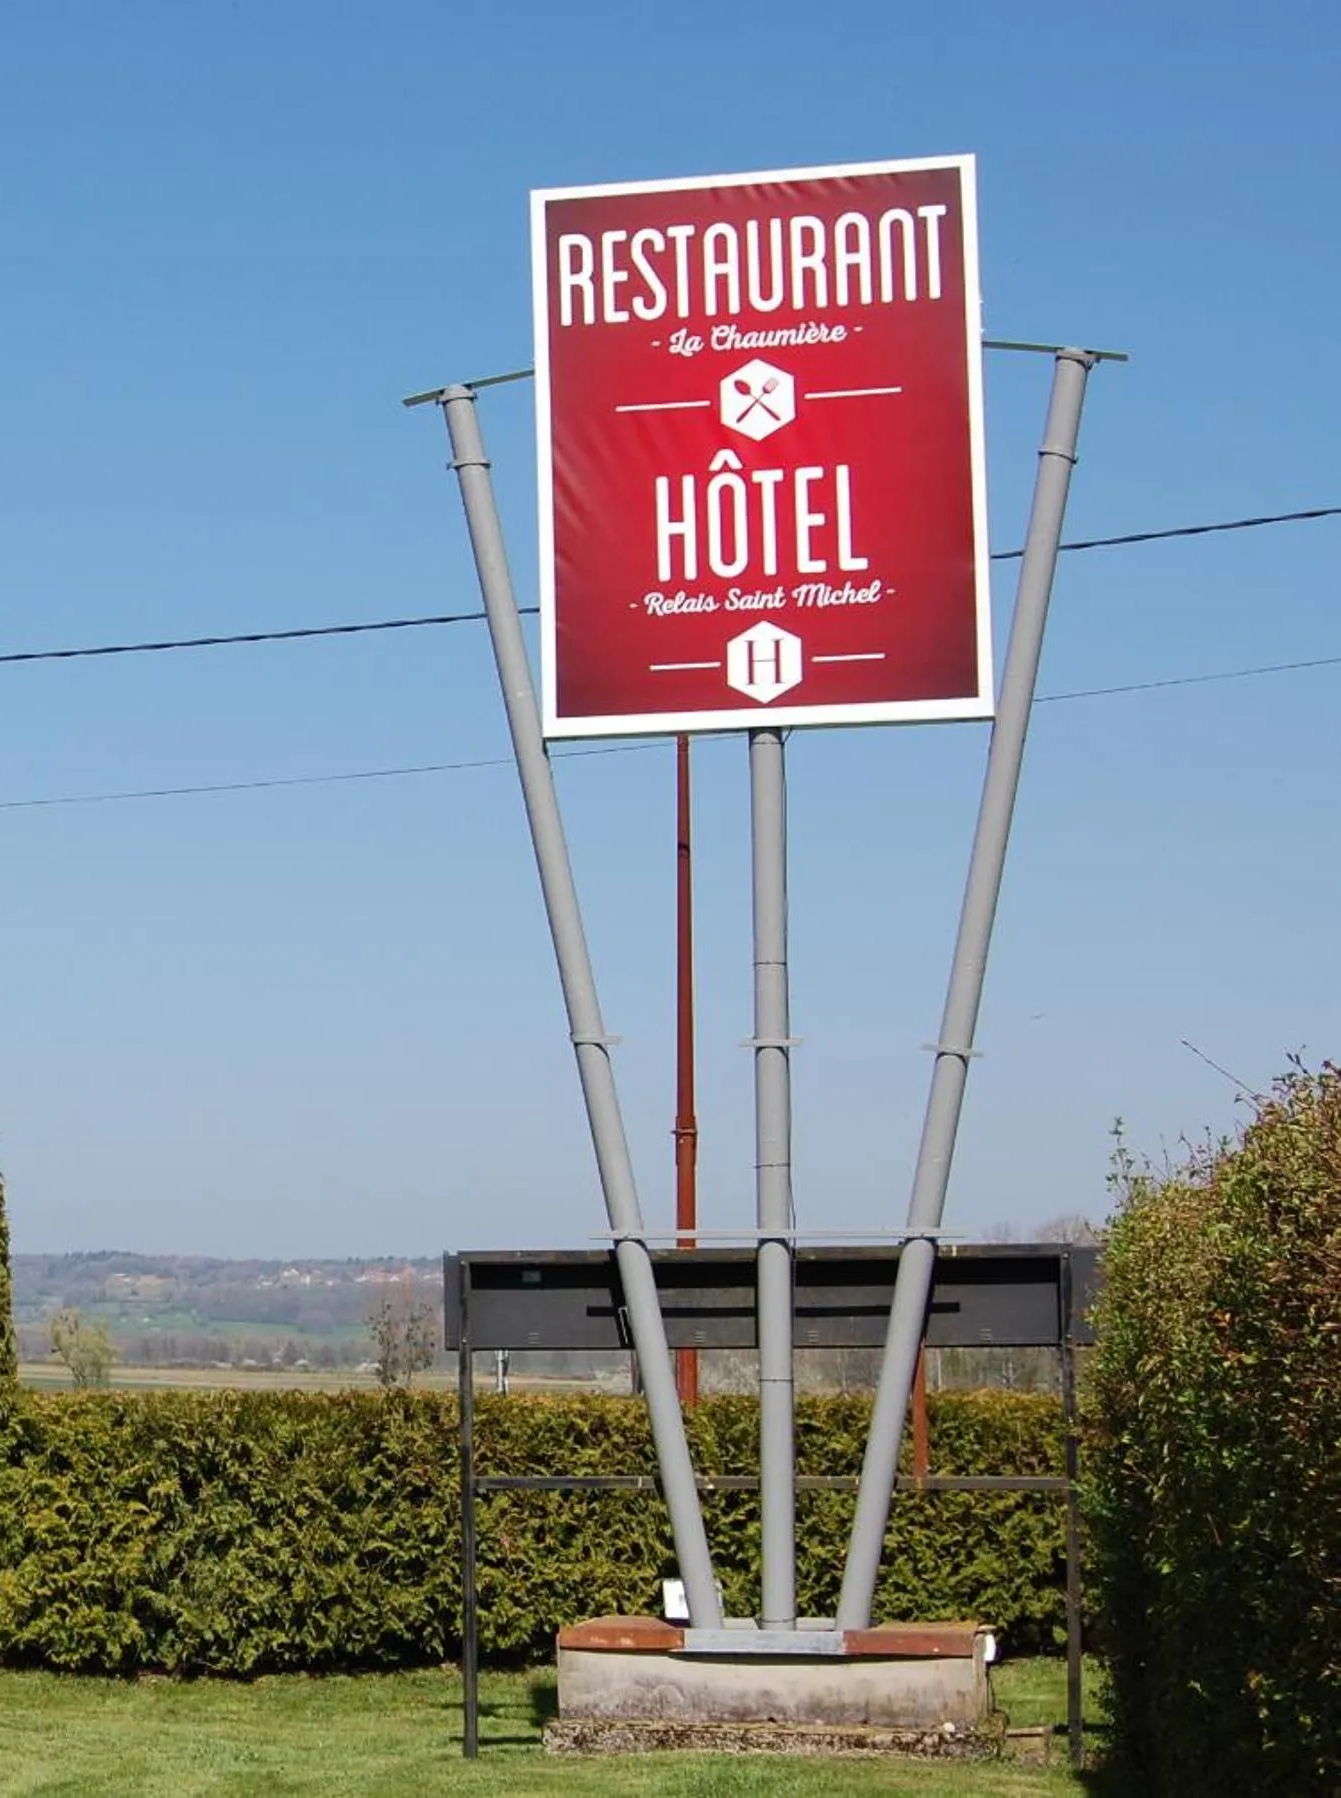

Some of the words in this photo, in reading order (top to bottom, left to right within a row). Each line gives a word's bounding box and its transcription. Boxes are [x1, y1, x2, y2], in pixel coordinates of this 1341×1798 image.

[558, 204, 947, 327] RESTAURANT
[668, 327, 704, 357] La
[710, 322, 848, 352] Chaumière
[655, 448, 869, 582] HÔTEL
[644, 590, 720, 616] Relais
[724, 585, 786, 612] Saint
[791, 579, 882, 608] Michel
[744, 636, 784, 686] H
